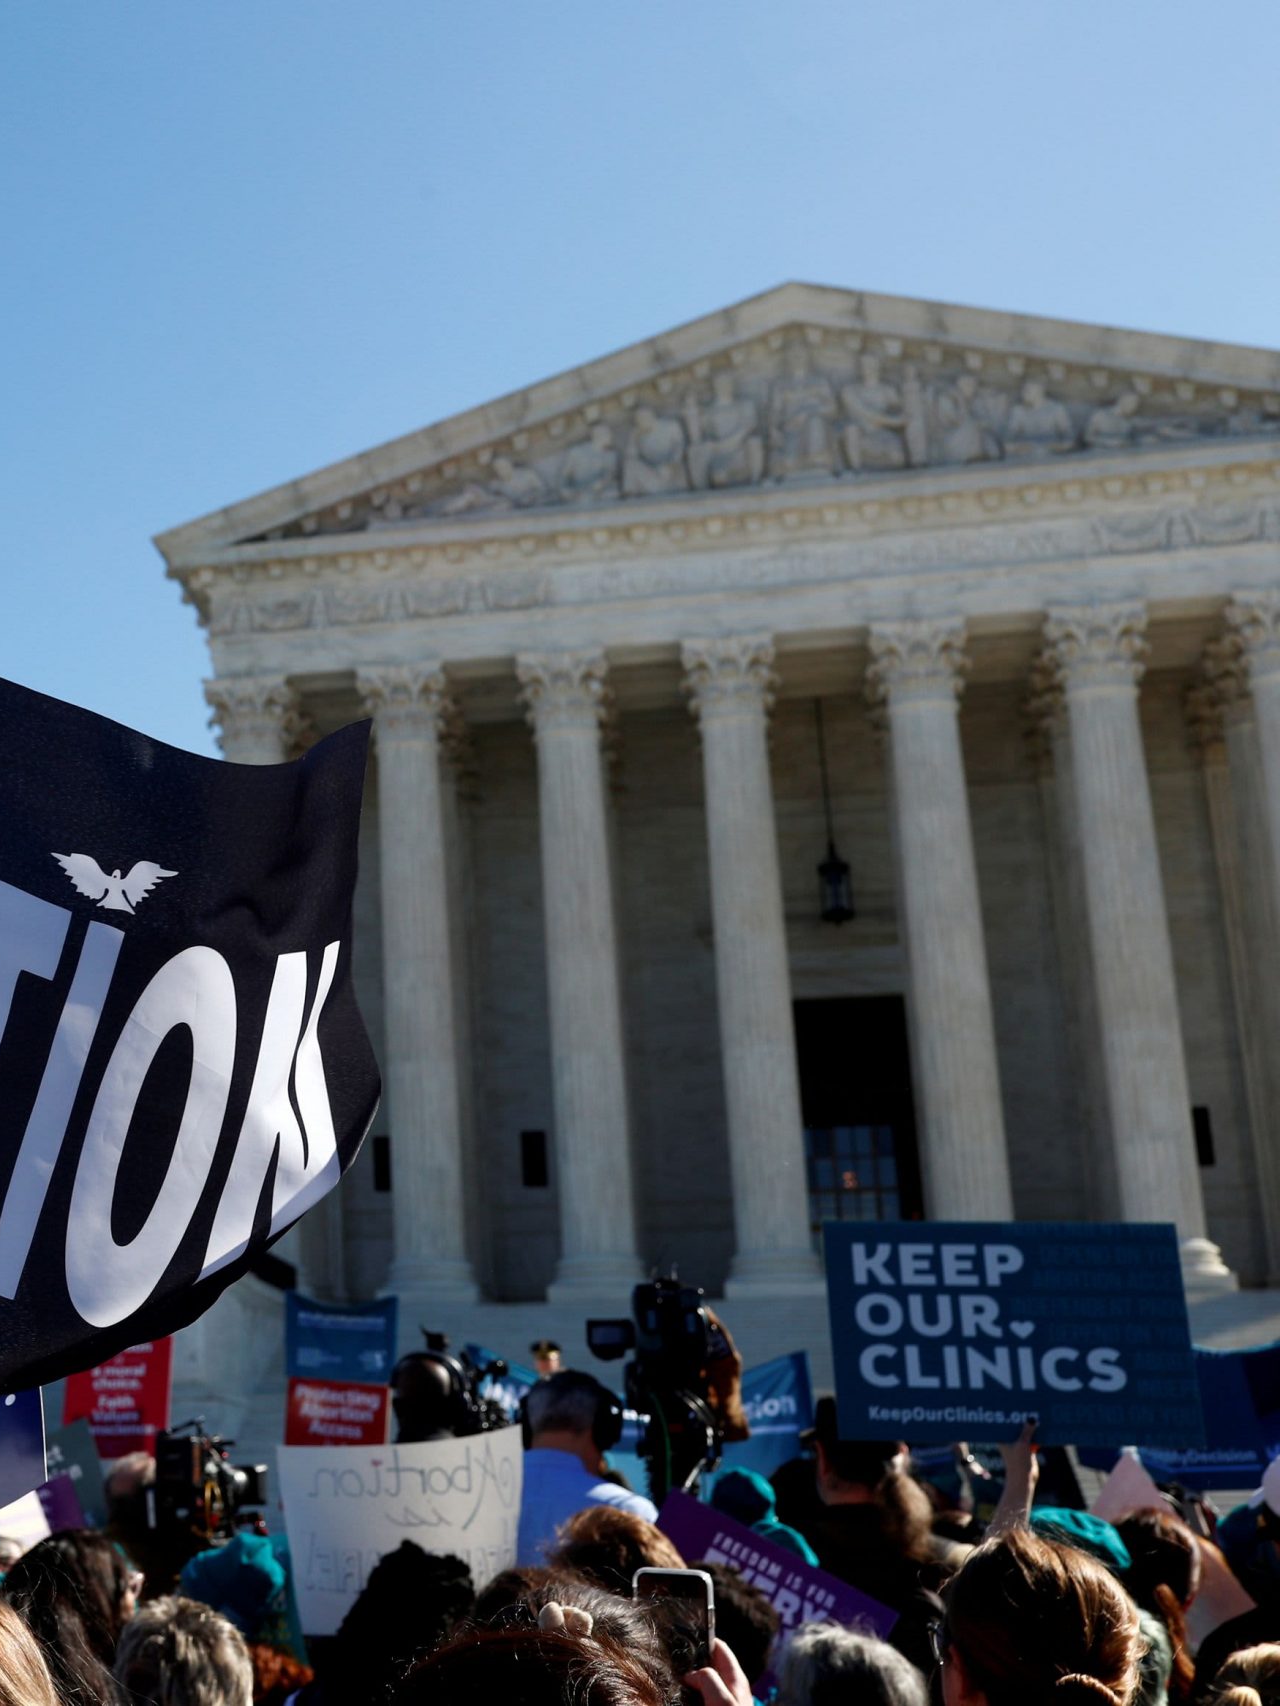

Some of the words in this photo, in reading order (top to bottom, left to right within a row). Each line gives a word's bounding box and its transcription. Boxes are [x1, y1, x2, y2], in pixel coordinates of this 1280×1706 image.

[851, 1243, 1024, 1287] KEEP
[855, 1293, 1003, 1338] OUR
[859, 1344, 1127, 1392] CLINICS
[868, 1404, 1040, 1427] KeepOurClinics.org
[712, 1532, 783, 1578] FREEDOM
[785, 1572, 804, 1591] IS
[806, 1583, 837, 1610] FOR
